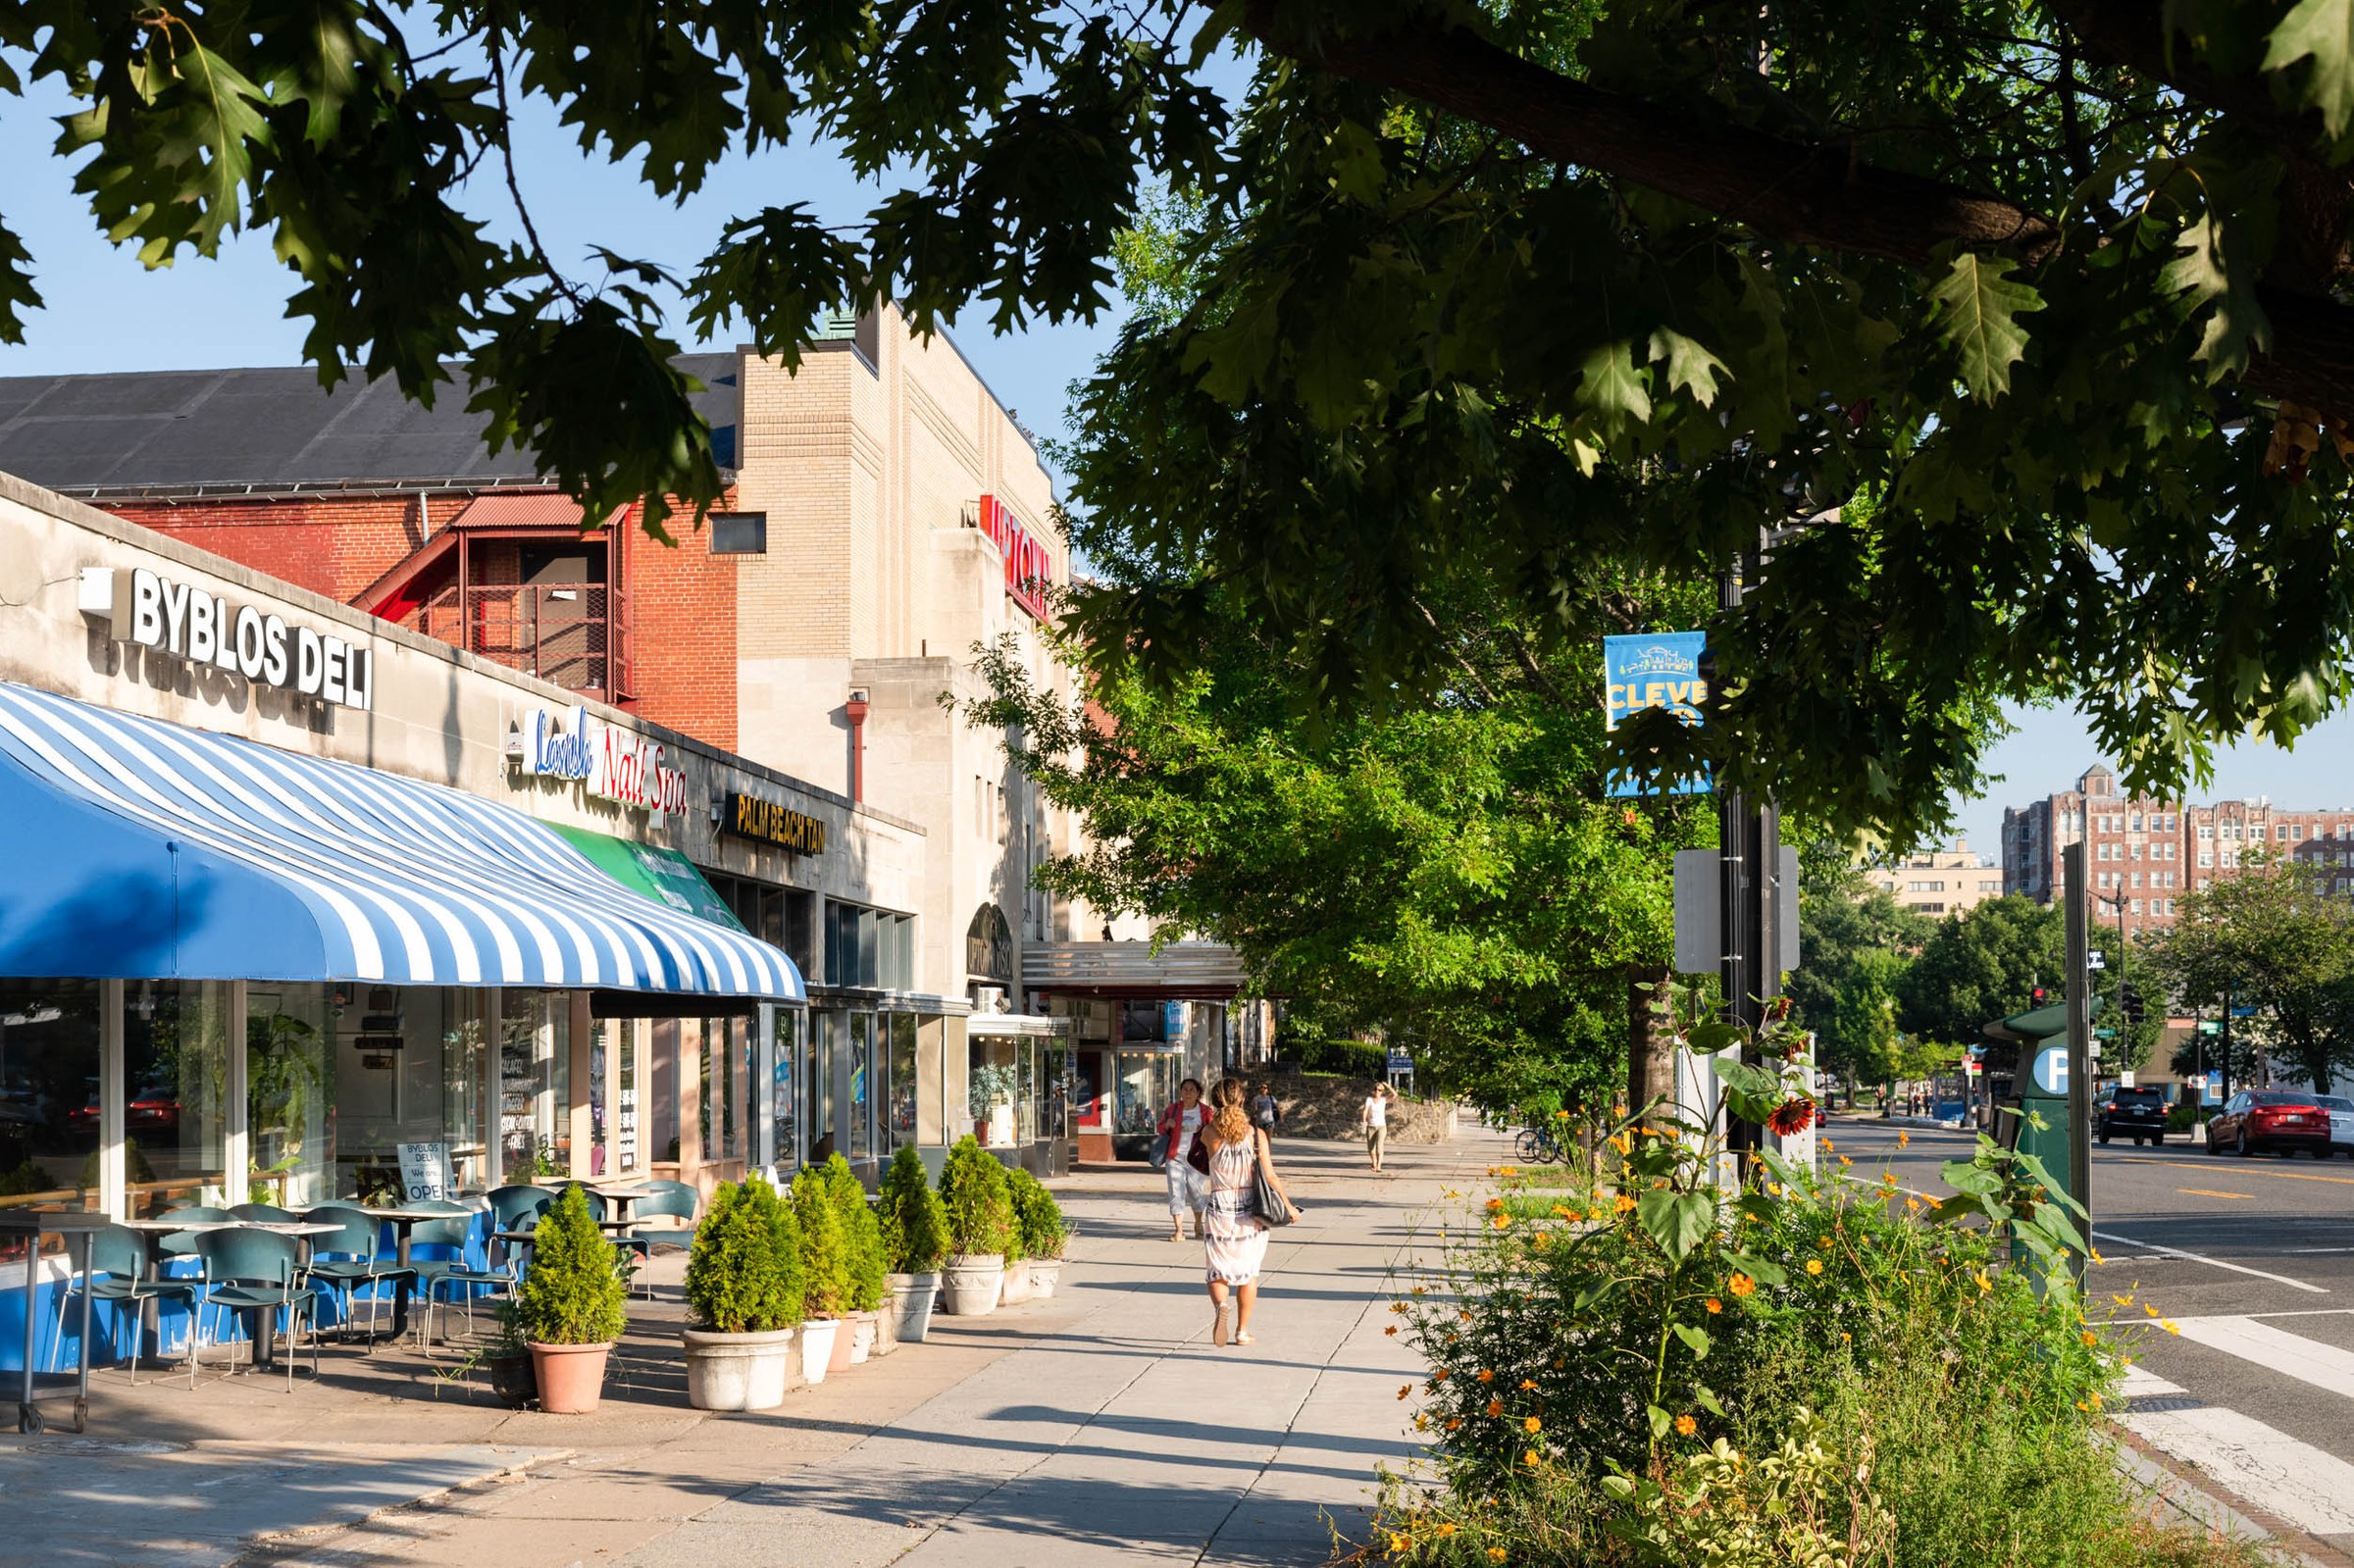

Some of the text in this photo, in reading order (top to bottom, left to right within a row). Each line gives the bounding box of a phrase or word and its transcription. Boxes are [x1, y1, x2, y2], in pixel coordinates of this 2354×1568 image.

[133, 568, 373, 710] BYBLOS DELI
[1609, 681, 1708, 710] CLEVE
[535, 705, 688, 829] Lavish Nail Spa
[737, 792, 826, 855] PALM BEACH TAN
[2049, 1049, 2069, 1090] P
[407, 1143, 438, 1153] BYBLOS
[415, 1153, 435, 1162] DELI
[411, 1168, 425, 1178] We
